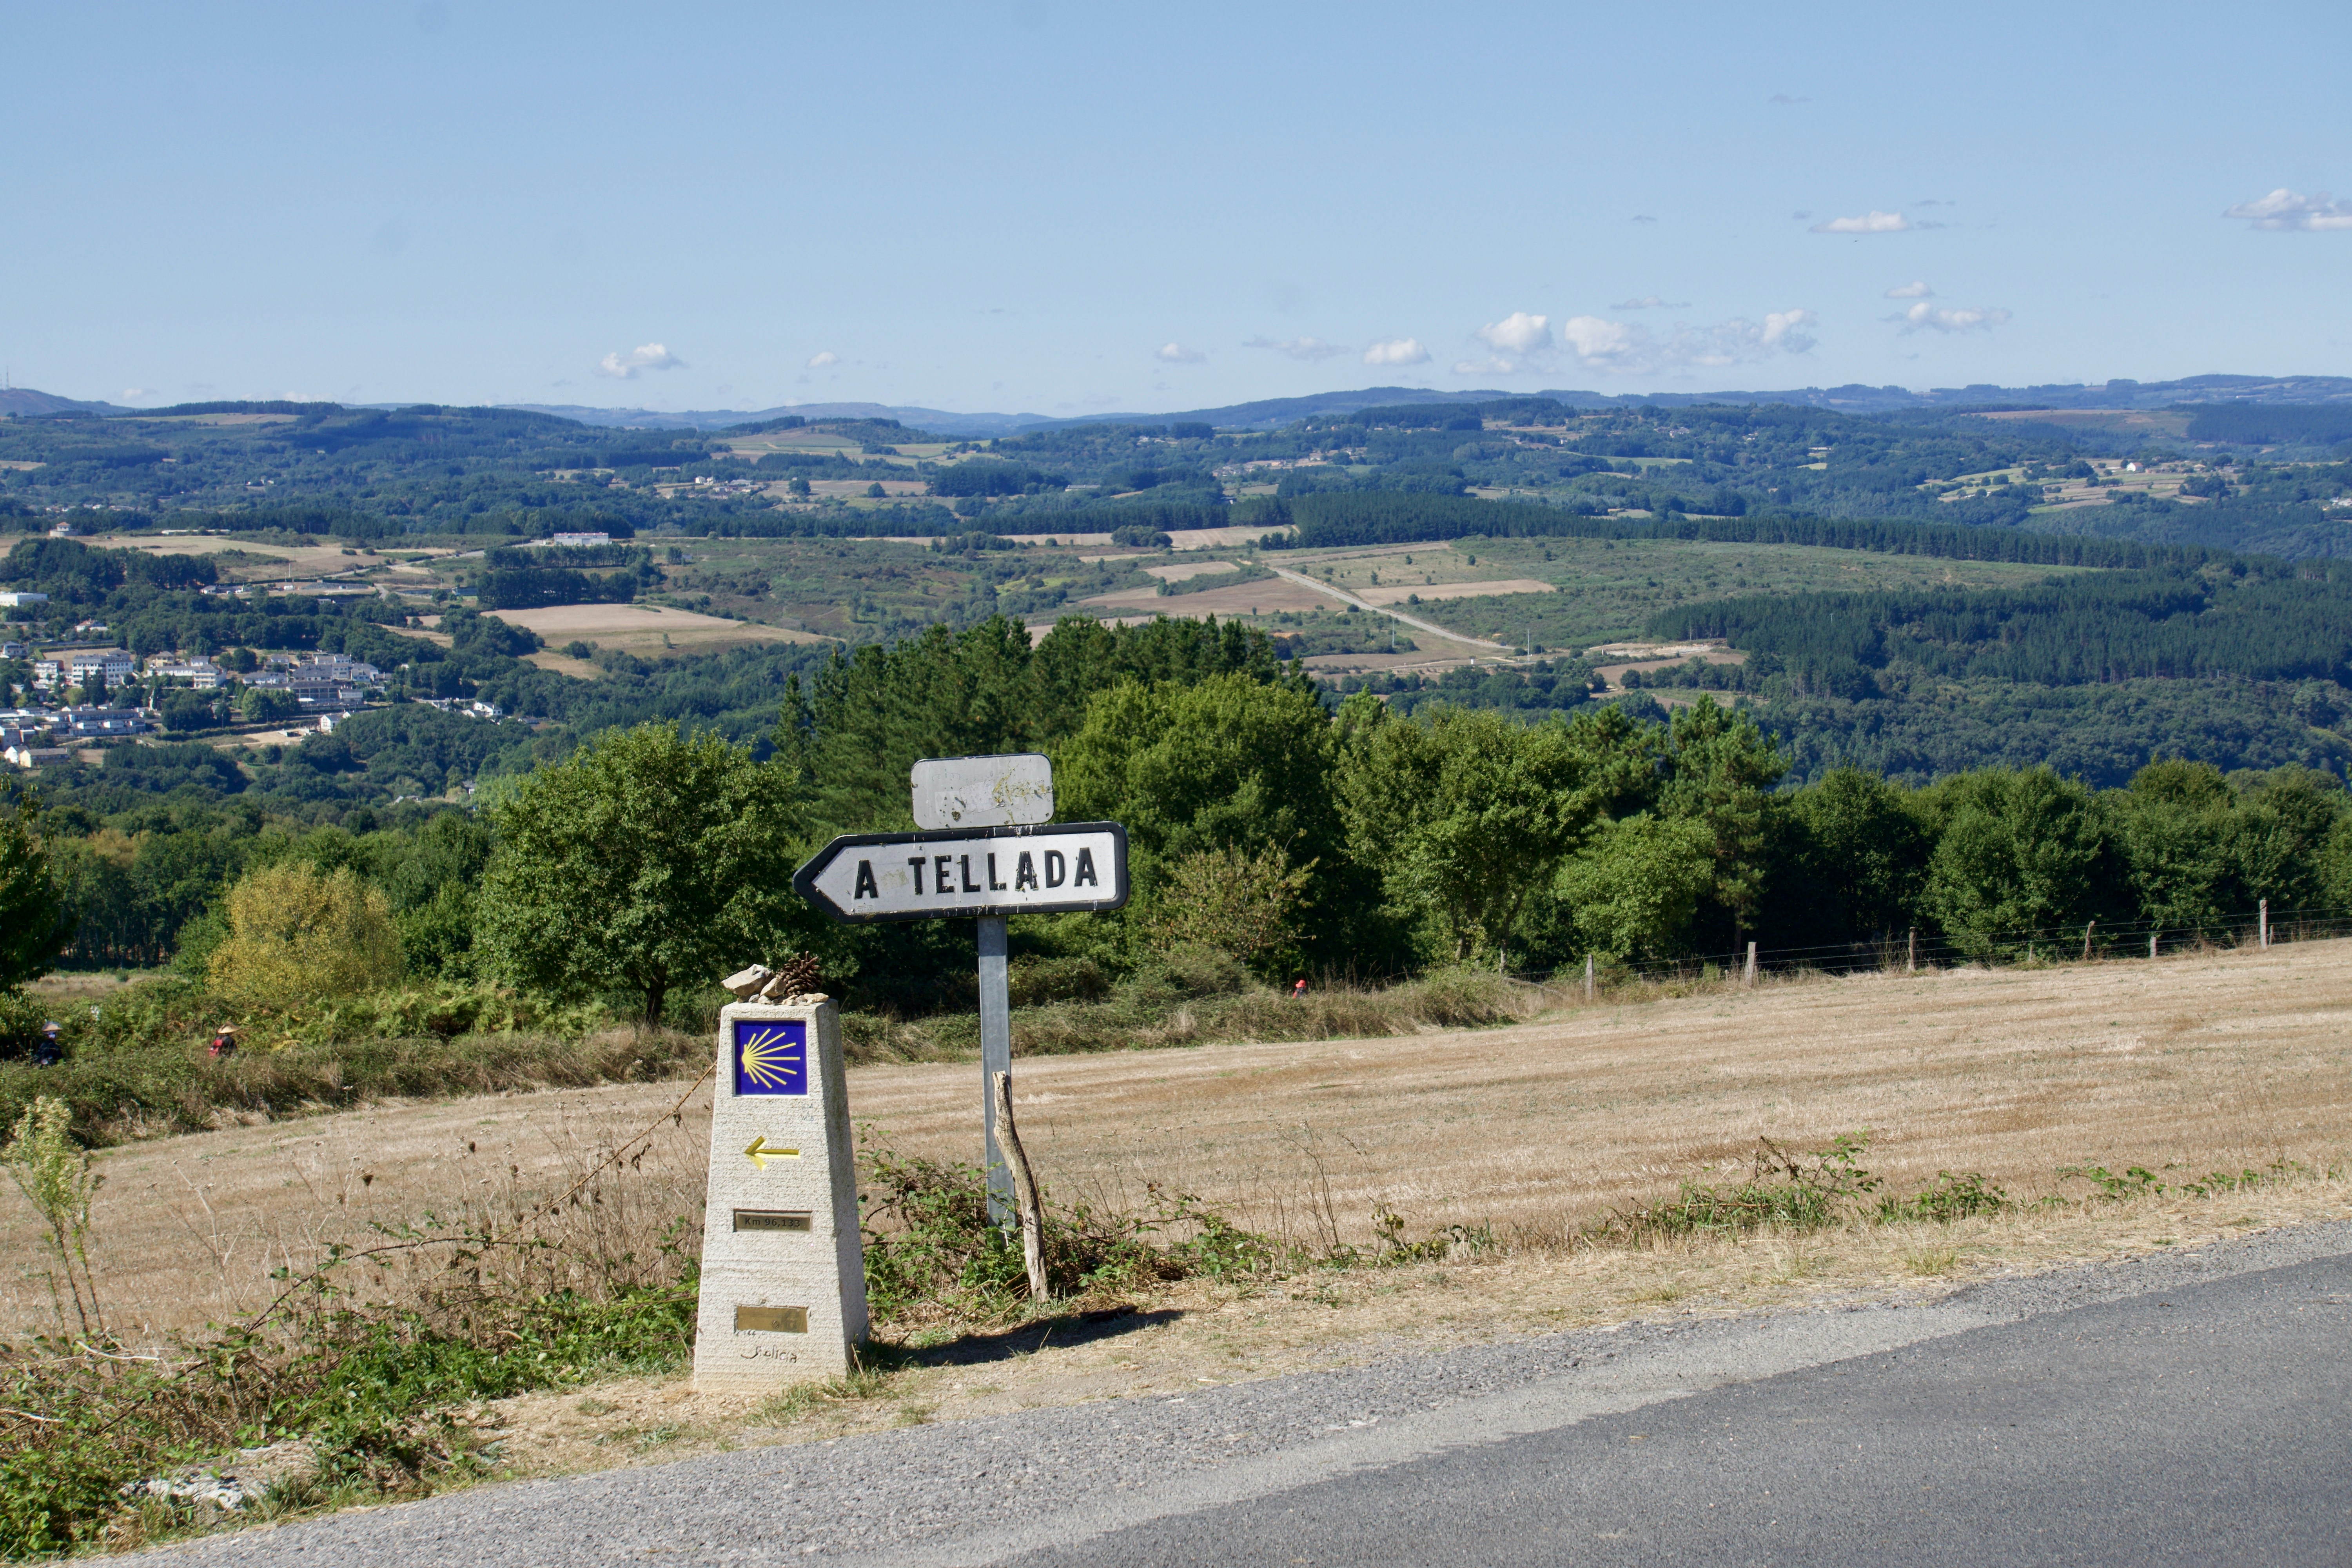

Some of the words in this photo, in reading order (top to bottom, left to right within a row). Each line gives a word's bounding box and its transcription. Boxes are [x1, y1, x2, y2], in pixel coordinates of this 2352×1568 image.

[854, 859, 879, 899] A
[908, 847, 1098, 895] TELLADA
[745, 1217, 760, 1226] Km
[765, 1218, 800, 1228] 96,133
